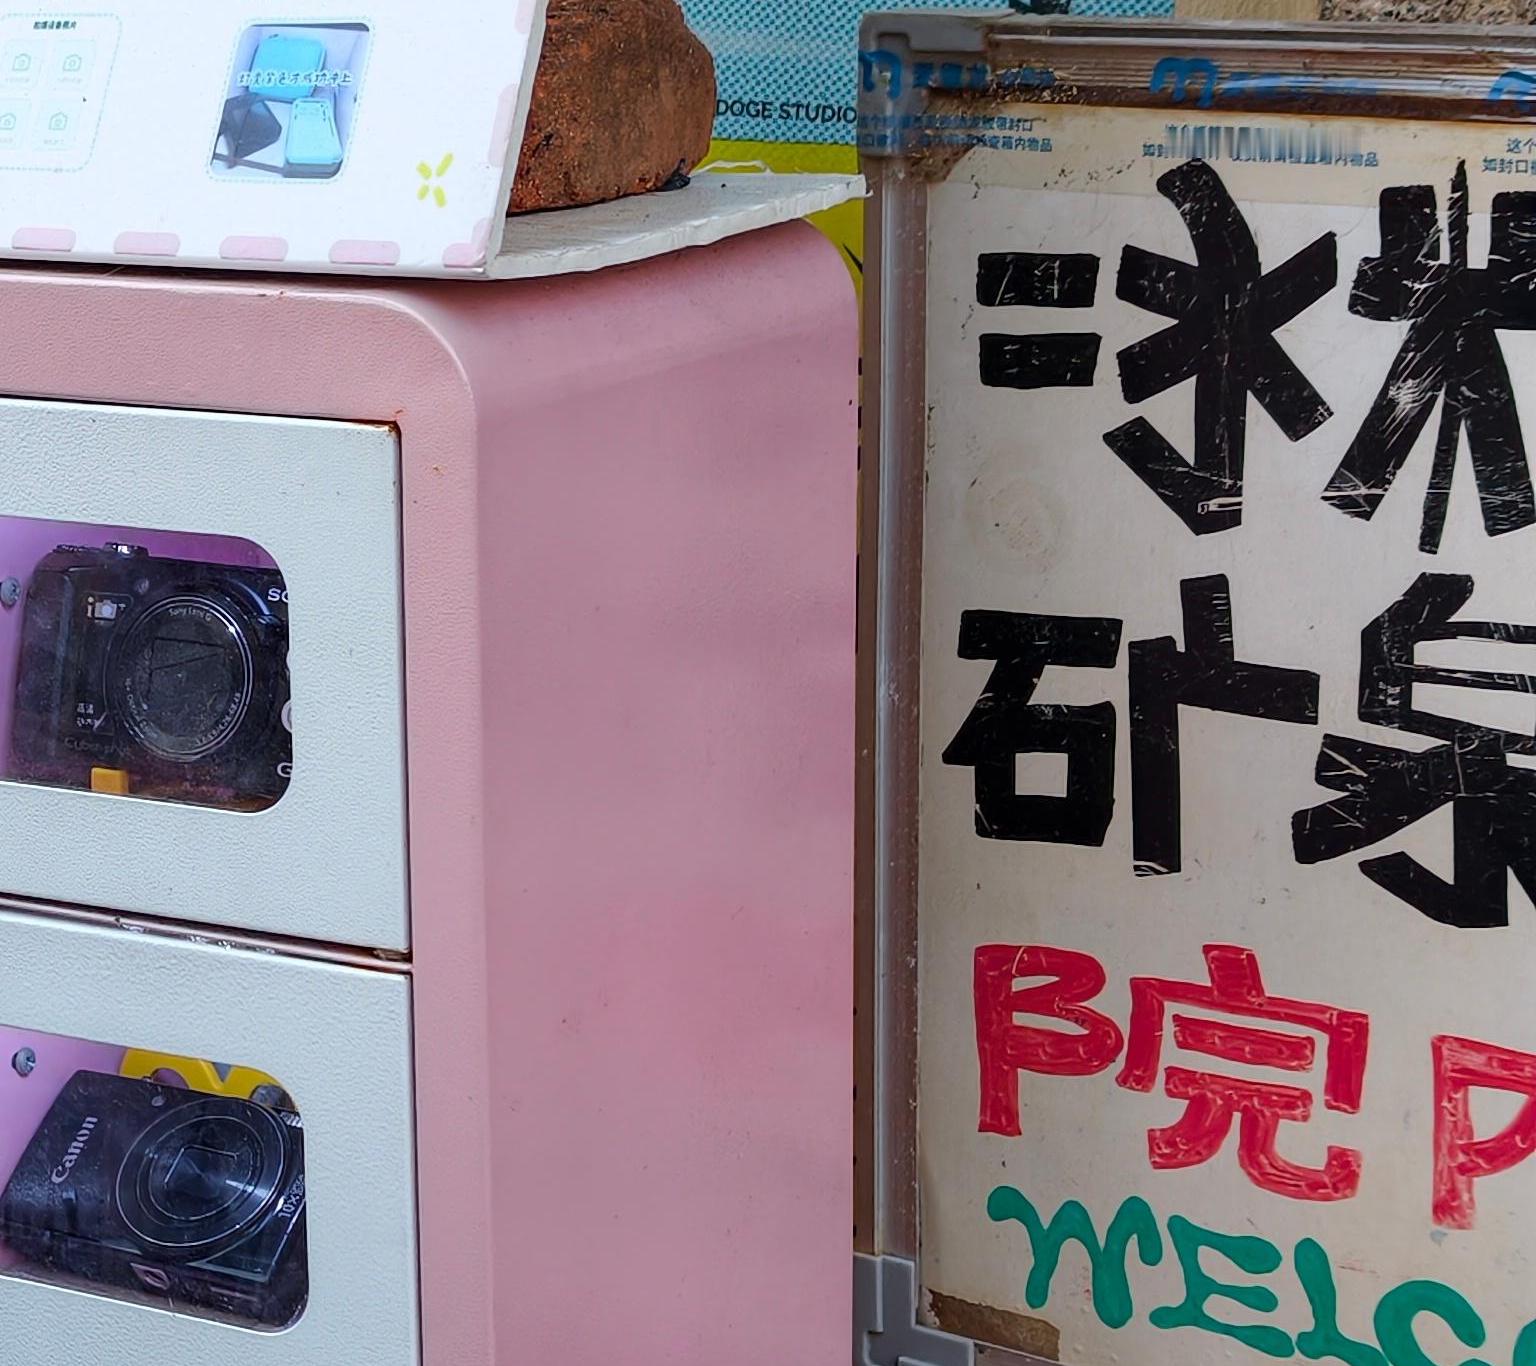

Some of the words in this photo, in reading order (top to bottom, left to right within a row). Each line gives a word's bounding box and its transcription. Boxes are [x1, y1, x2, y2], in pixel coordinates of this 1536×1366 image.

[714, 99, 774, 120] DOGE
[778, 101, 858, 124] STUDIO
[51, 1114, 99, 1186] Canon
